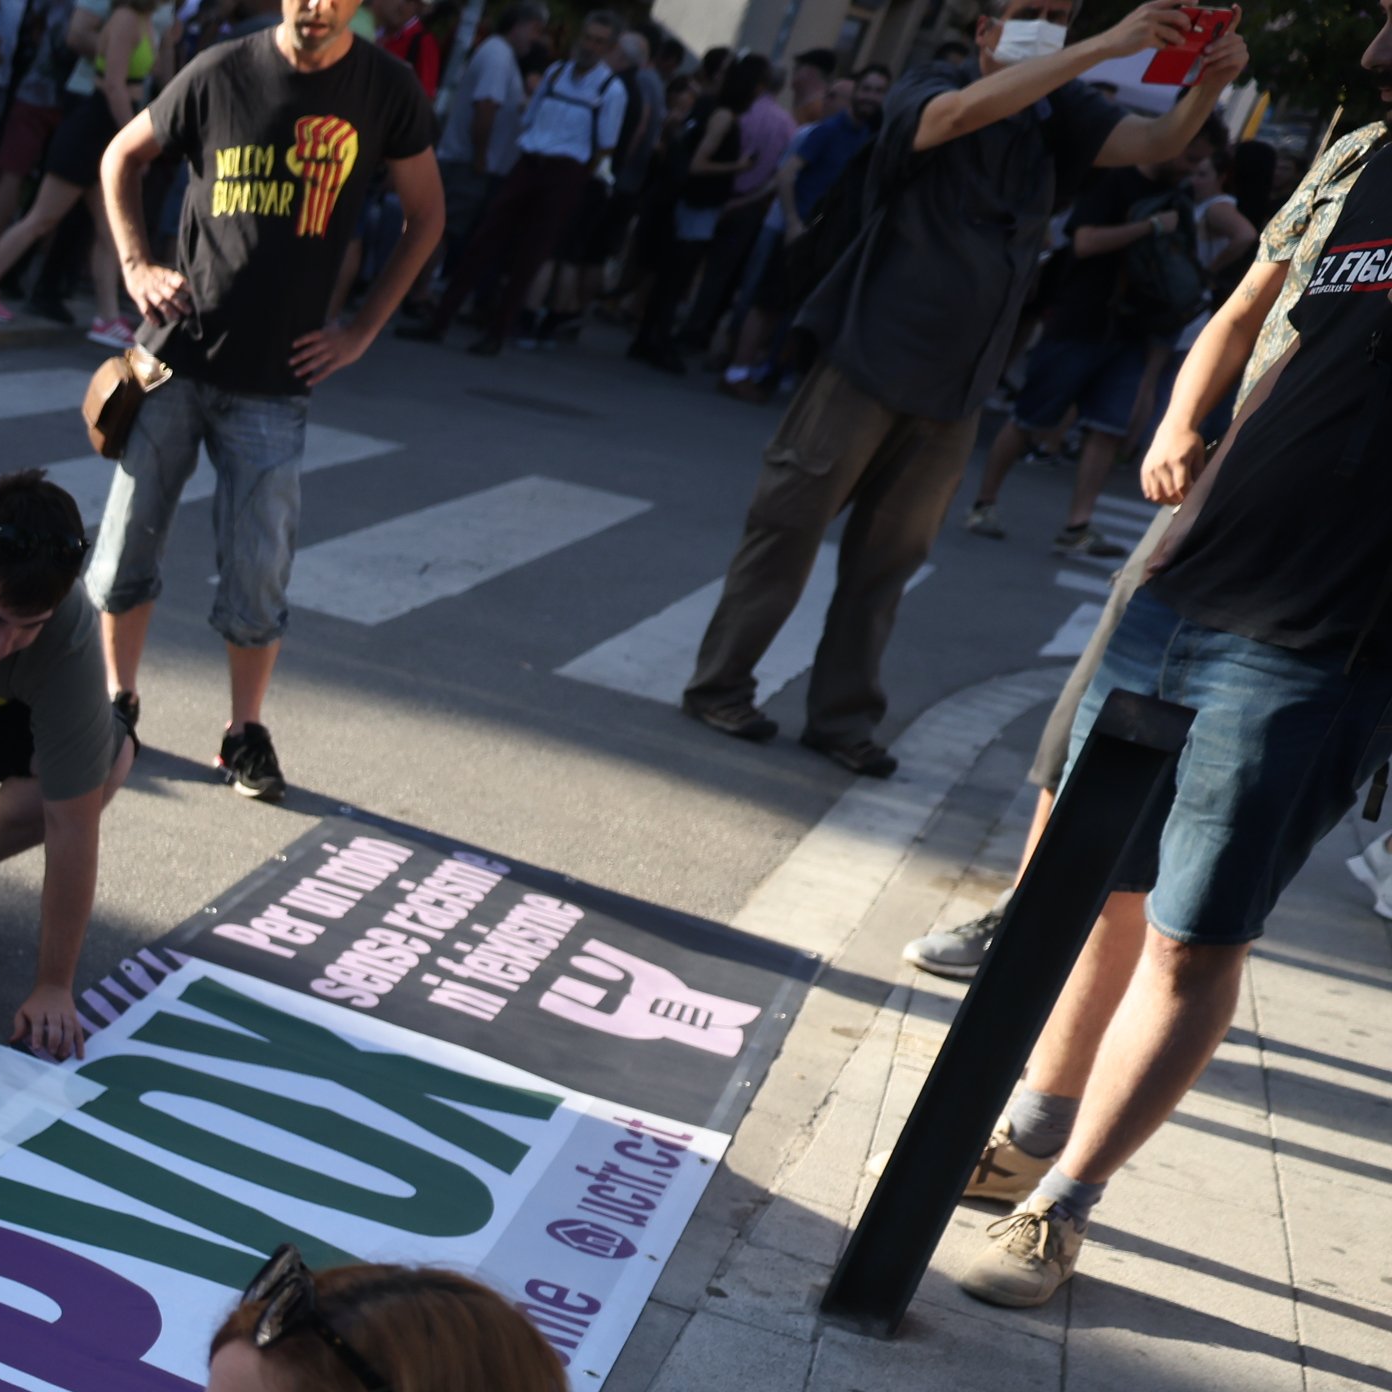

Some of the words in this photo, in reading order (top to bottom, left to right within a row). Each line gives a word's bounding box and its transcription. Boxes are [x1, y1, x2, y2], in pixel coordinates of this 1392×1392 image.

[215, 144, 275, 180] VOLEM
[211, 179, 295, 217] GUANYAR
[315, 836, 415, 892] món
[280, 876, 365, 919] un
[213, 904, 326, 958] Per
[310, 926, 432, 1008] sense
[382, 850, 511, 940] racisme
[436, 892, 586, 992] feixisme
[421, 972, 509, 1021] ni
[576, 1116, 694, 1228] ucfr.cat
